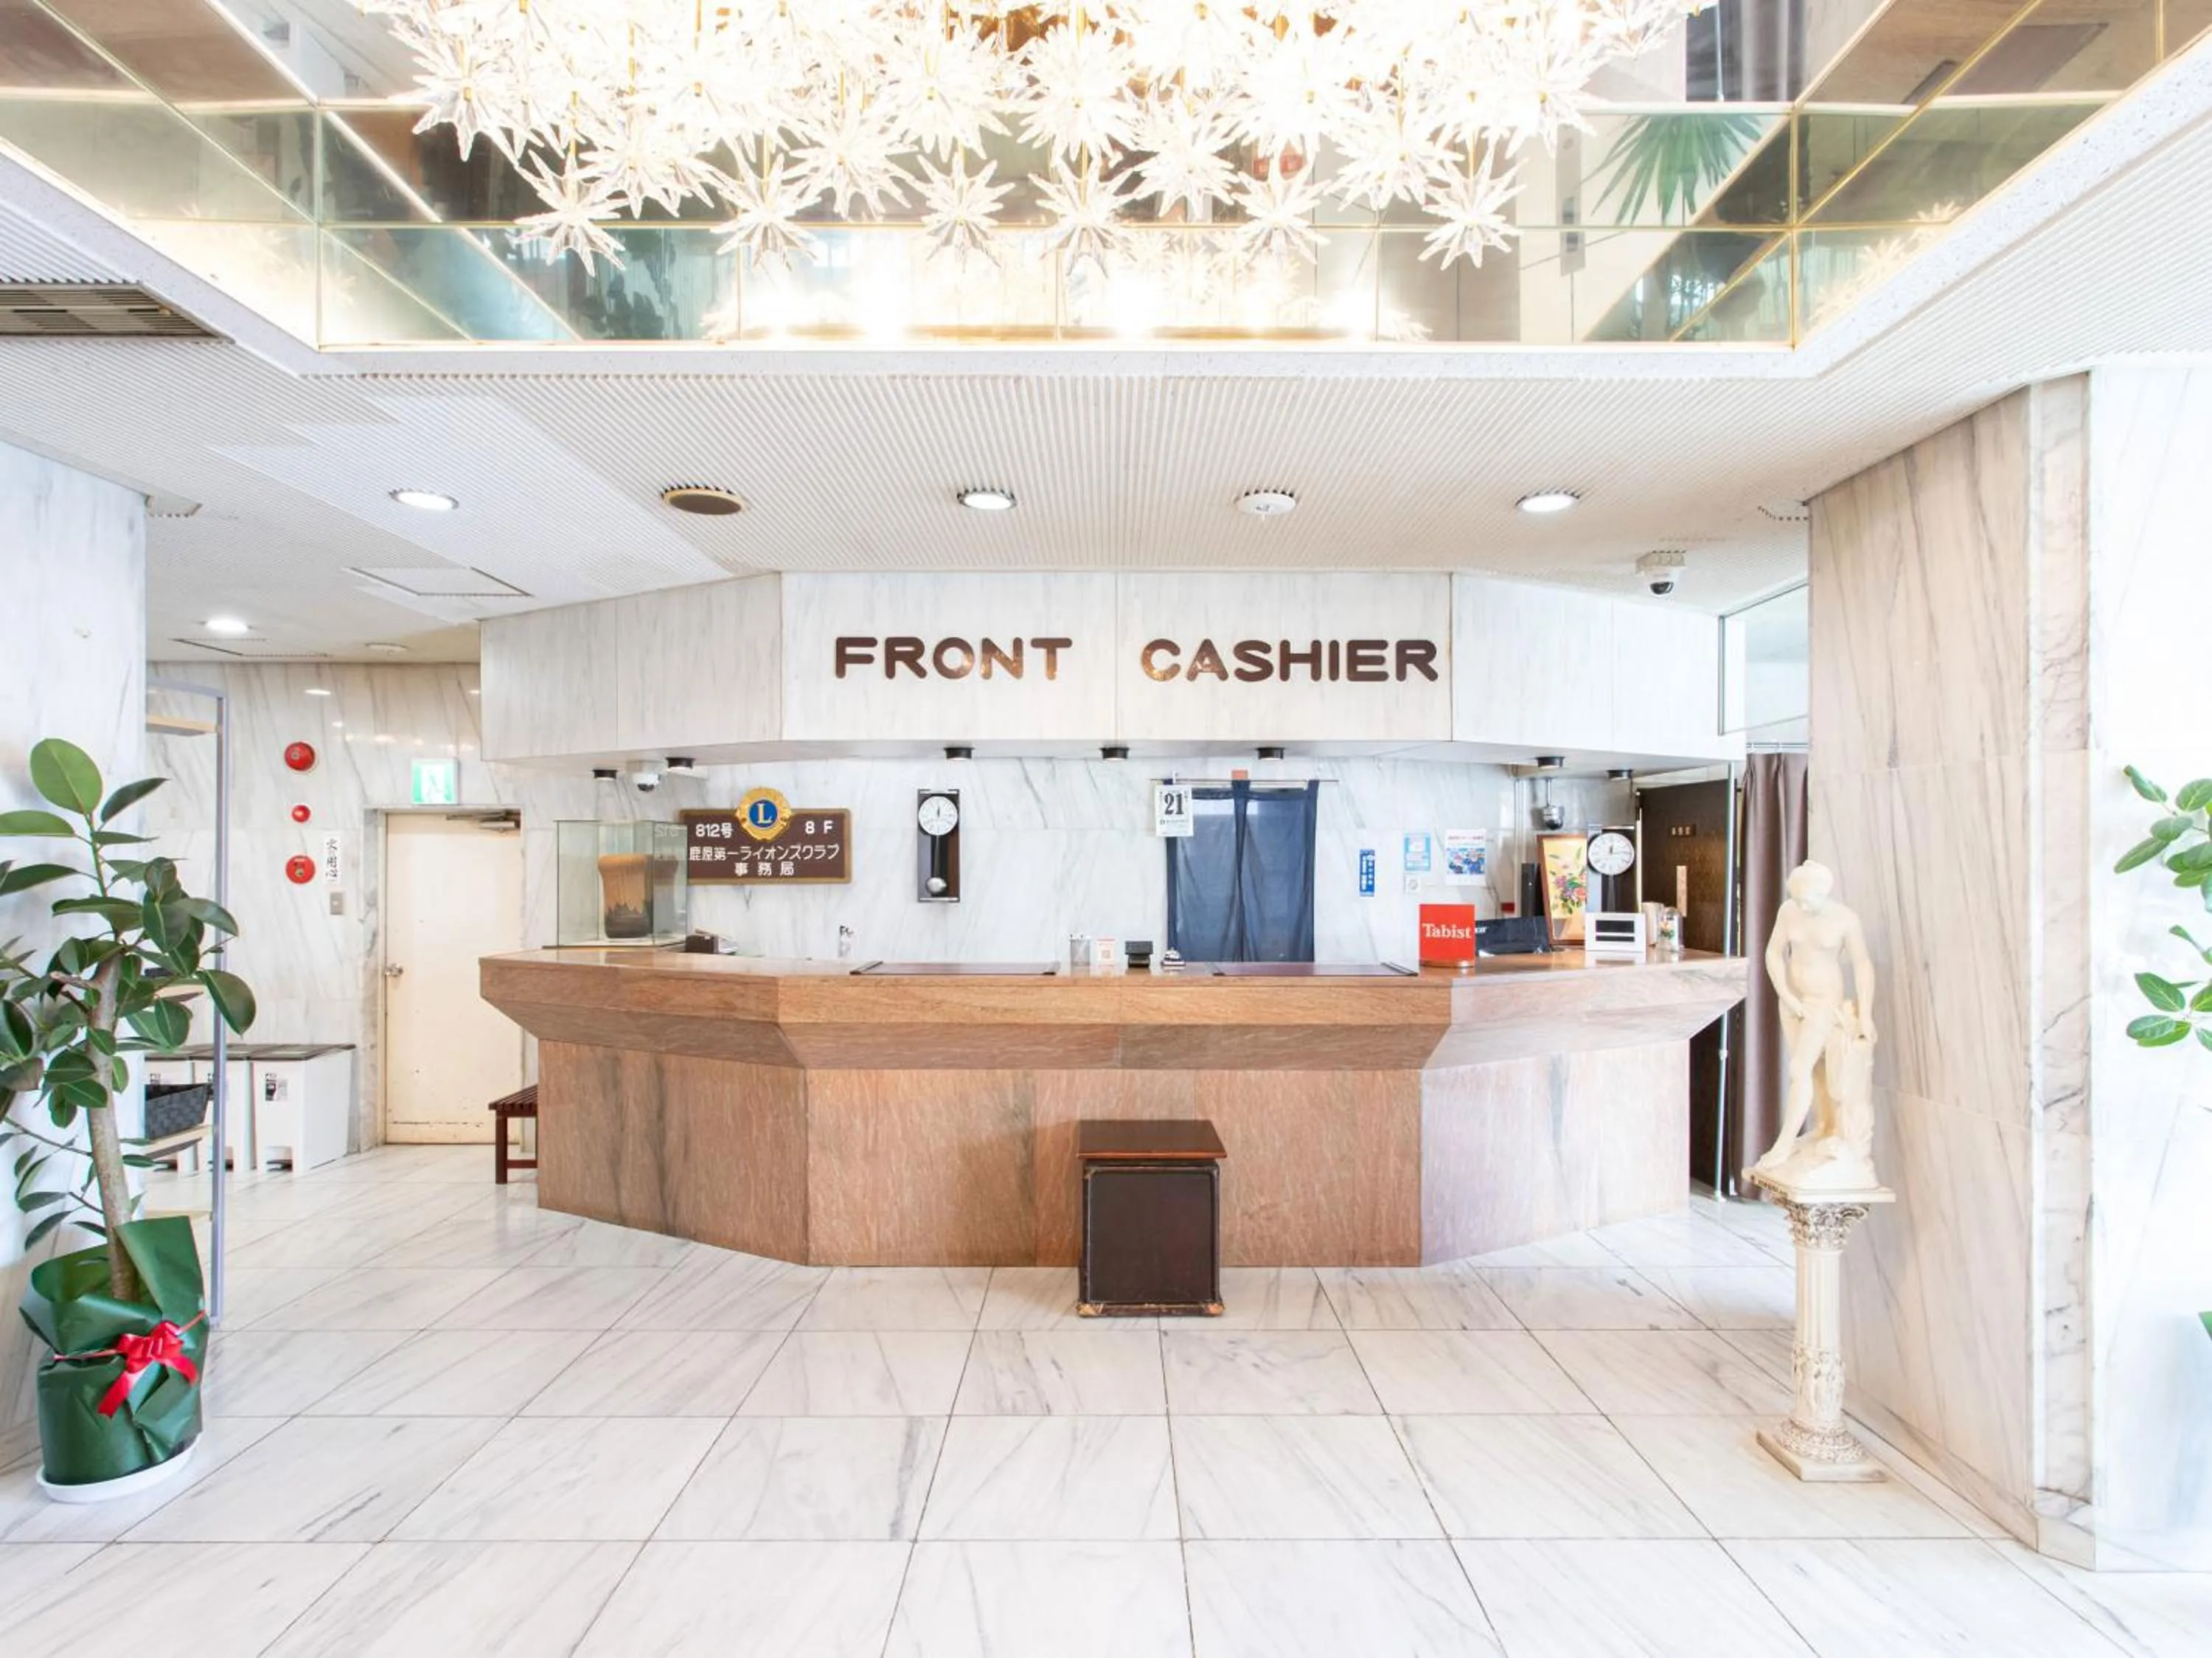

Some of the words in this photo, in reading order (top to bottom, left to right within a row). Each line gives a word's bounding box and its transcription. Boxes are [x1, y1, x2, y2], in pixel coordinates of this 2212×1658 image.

[835, 637, 1073, 680] FRONT
[1141, 639, 1439, 682] CASHIER
[757, 803, 772, 824] L
[1164, 793, 1183, 815] 21
[695, 822, 734, 839] 812号
[1422, 923, 1472, 939] Tabist
